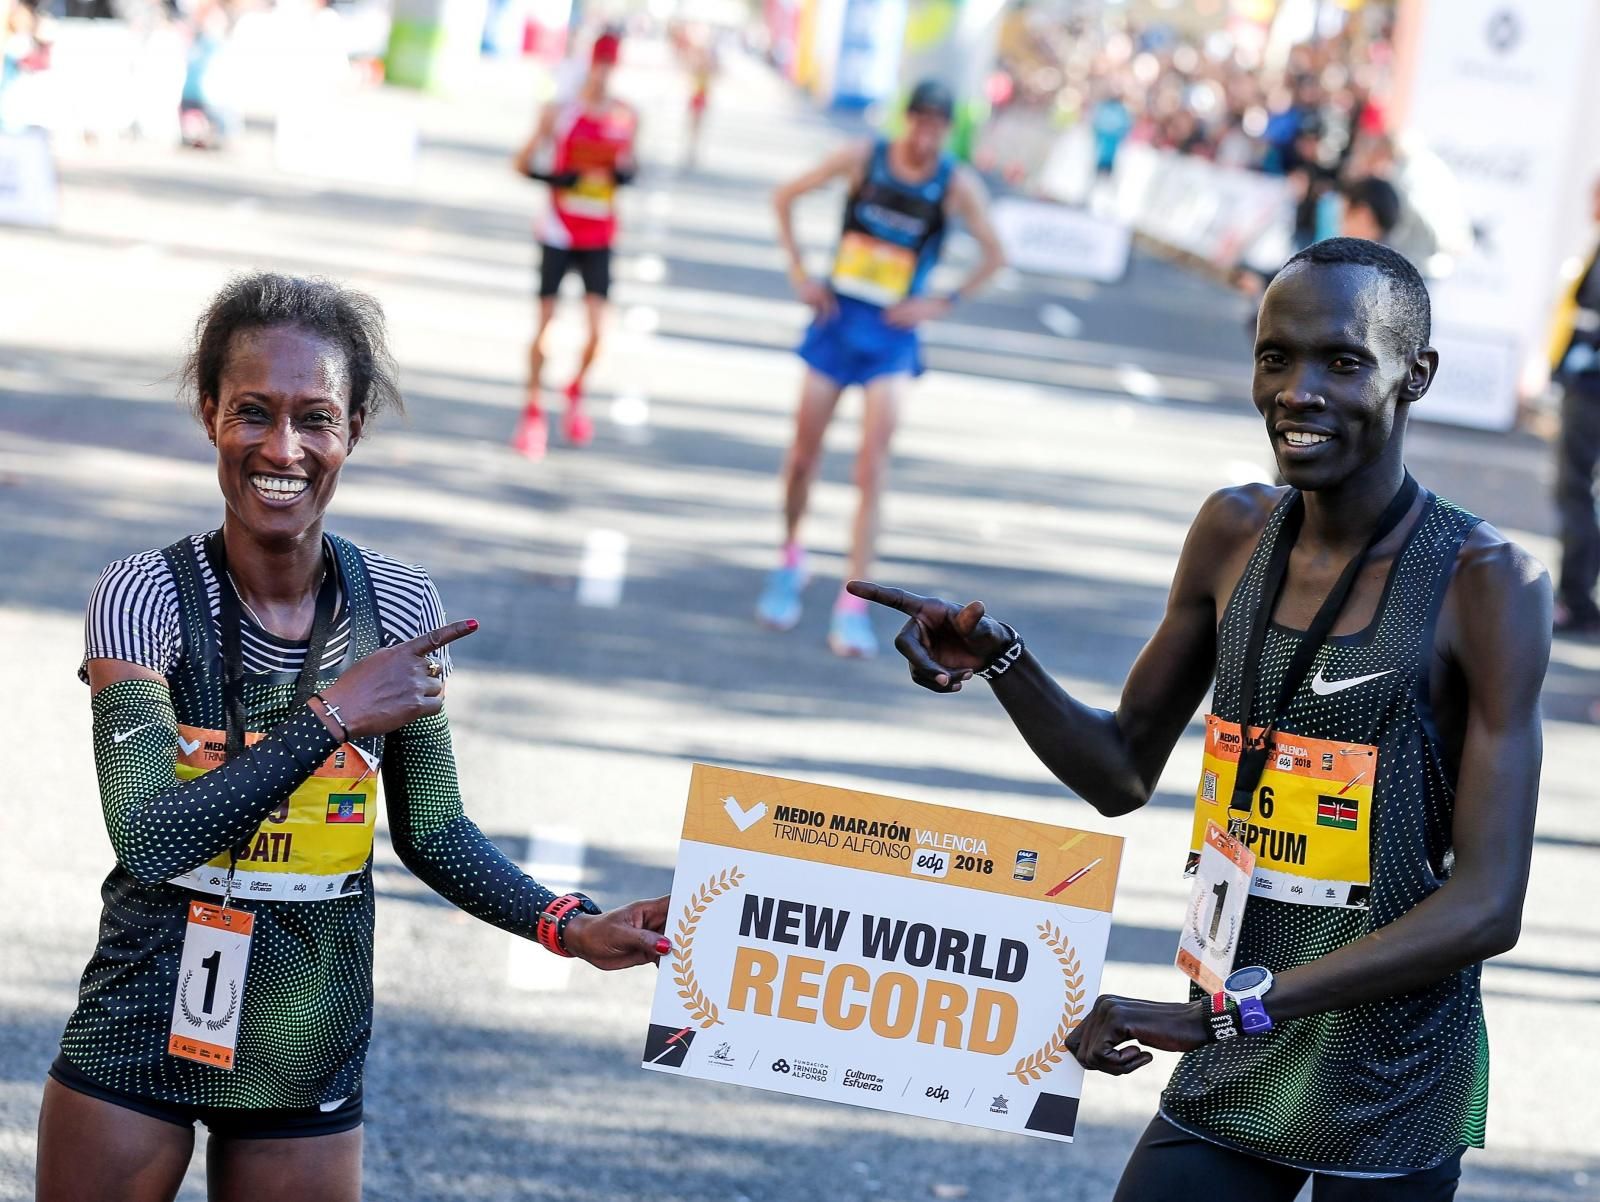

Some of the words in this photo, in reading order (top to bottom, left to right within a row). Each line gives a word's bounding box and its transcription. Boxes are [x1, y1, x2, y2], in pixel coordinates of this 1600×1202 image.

[1220, 732, 1240, 744] MEDIO
[204, 741, 226, 752] MED
[1278, 743, 1308, 757] VALENCIA
[1294, 757, 1312, 769] 2018
[1259, 786, 1275, 819] 6
[774, 805, 825, 827] MEDIO
[829, 814, 911, 842] MARATÓN
[915, 829, 988, 855] VALENCIA
[773, 823, 839, 848] TRINIDAD
[842, 836, 911, 860] ALFONSO
[916, 853, 944, 873] edp
[954, 854, 994, 875] 2018
[293, 883, 307, 893] edp
[1209, 880, 1229, 942] 1
[739, 894, 850, 952] NEW
[862, 914, 1029, 983] WORLD
[202, 951, 221, 1014] 1
[728, 946, 1018, 1056] RECORD
[792, 1071, 827, 1082] ALFONSO
[793, 1064, 828, 1076] TRINIDAD
[845, 1069, 876, 1082] Cultura
[843, 1077, 883, 1092] Esfuerzo
[925, 1085, 950, 1103] edp
